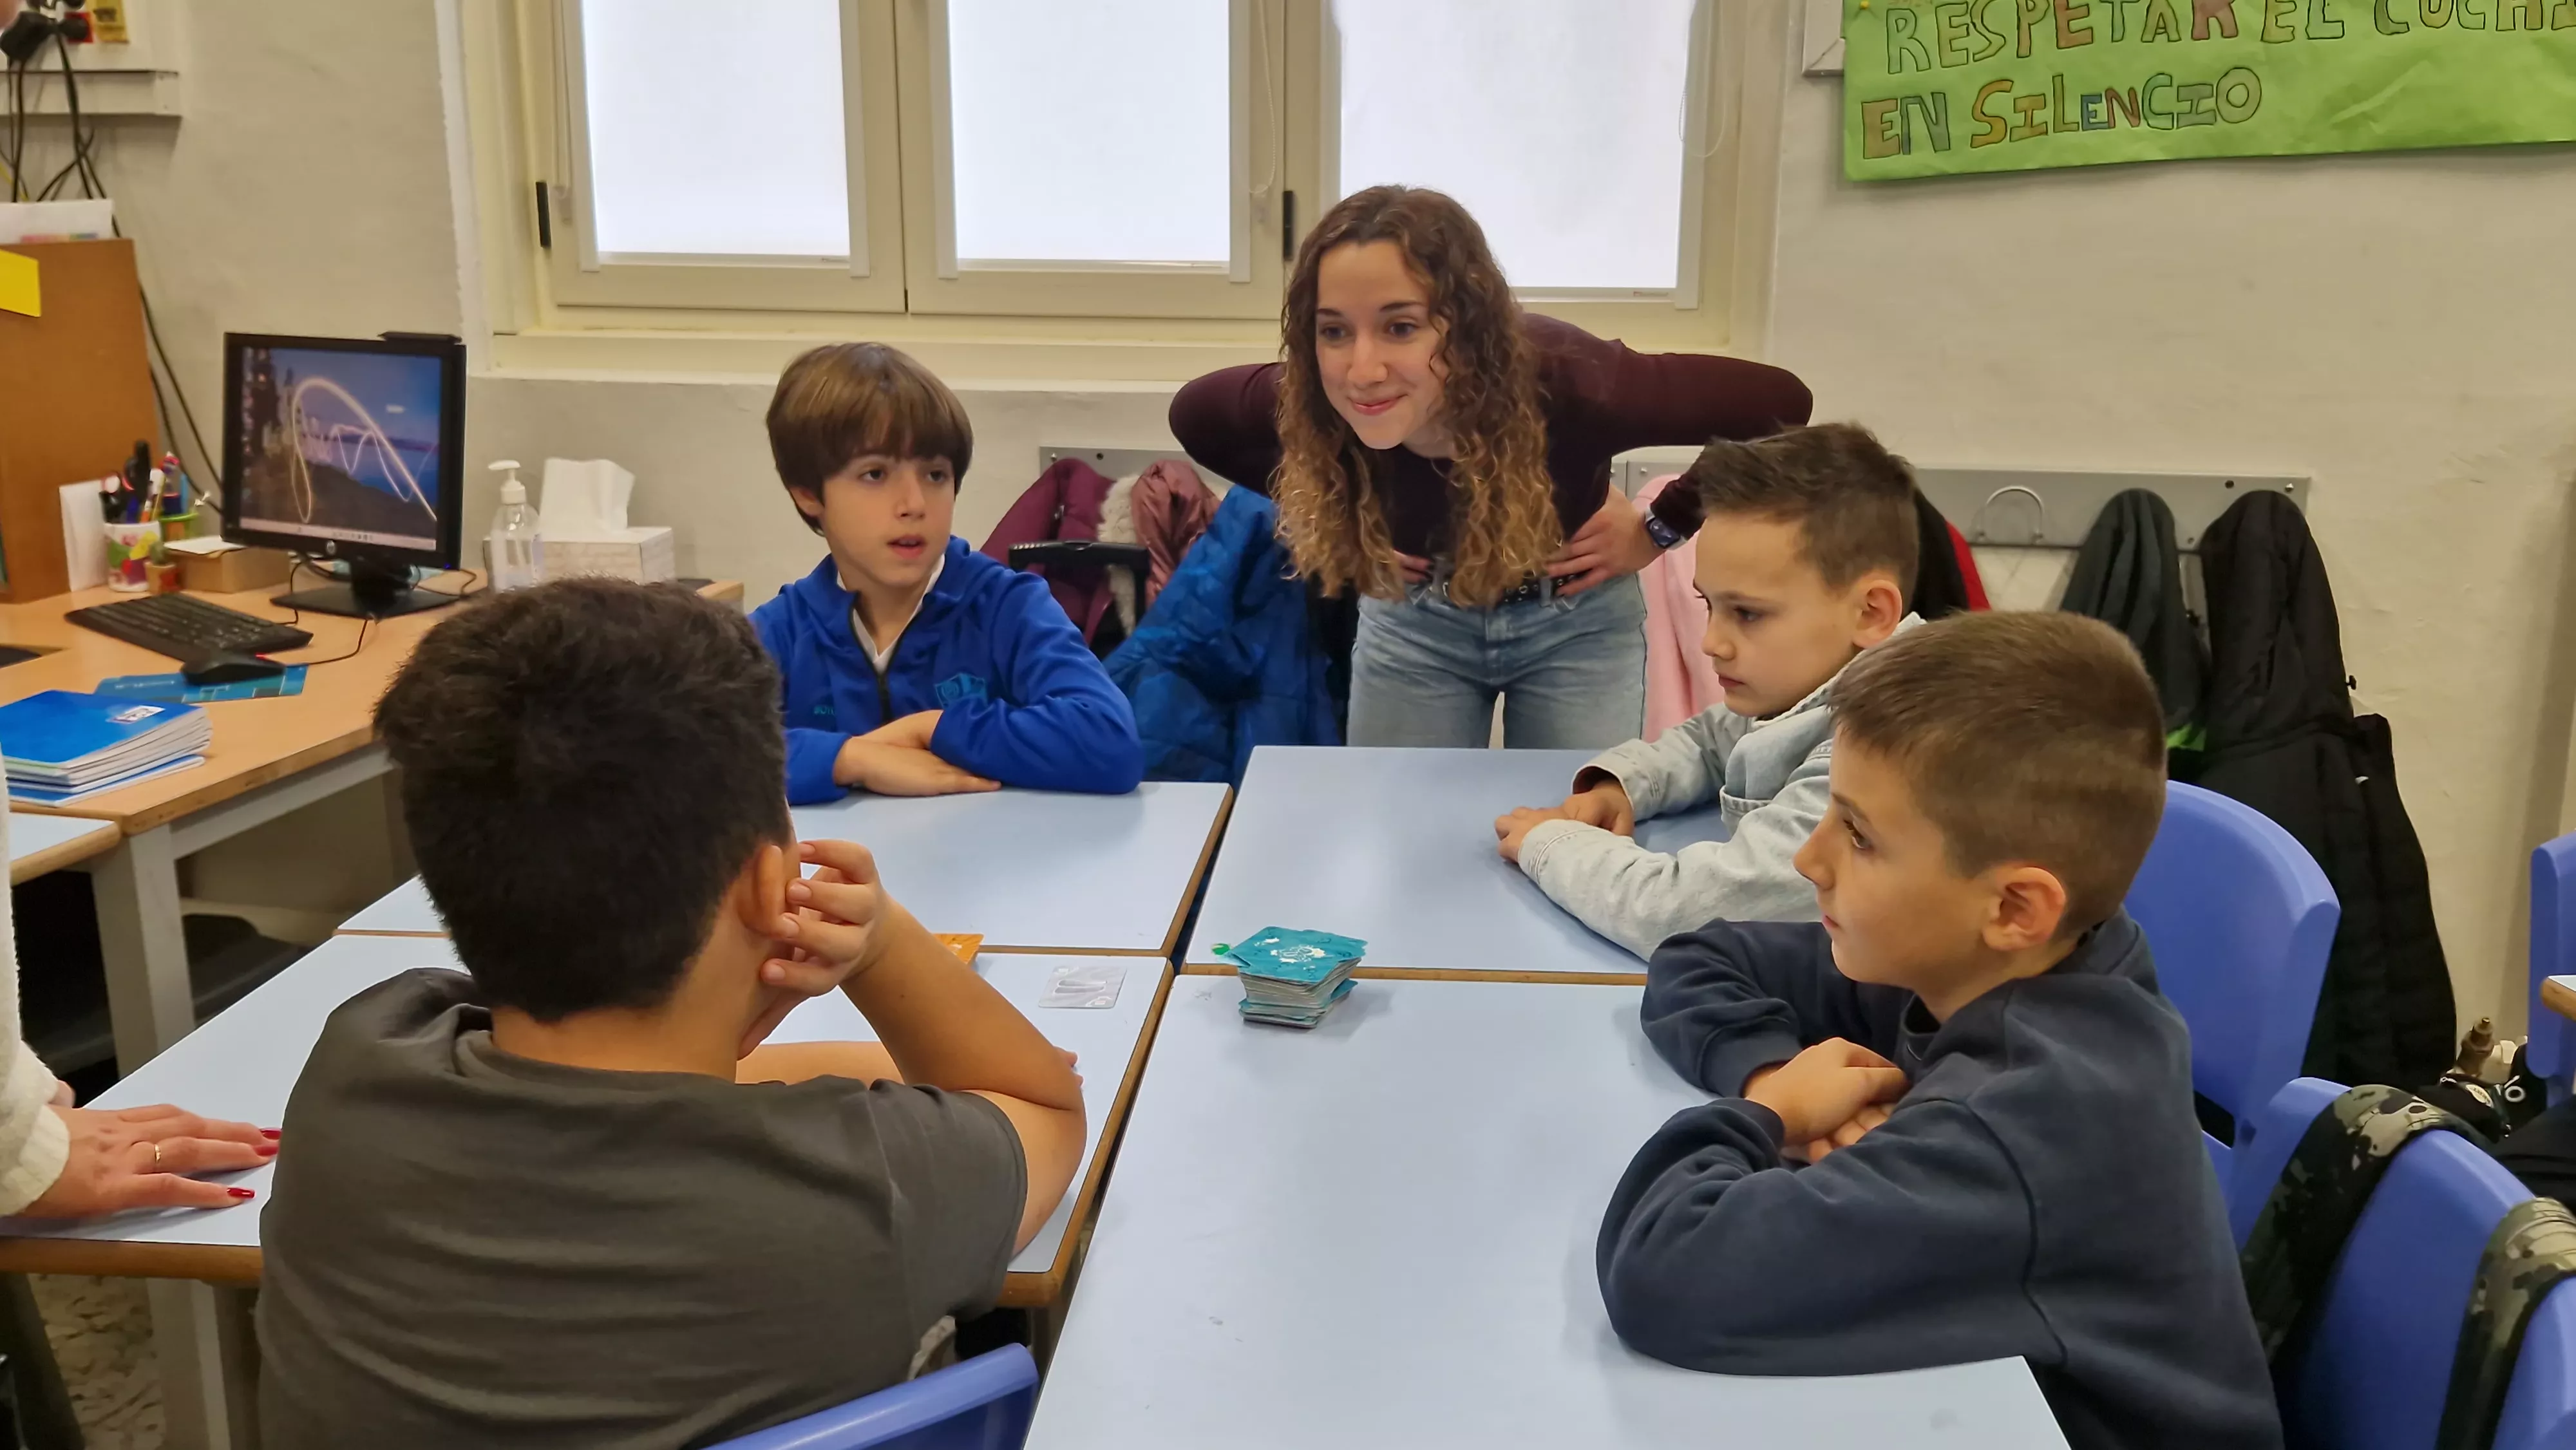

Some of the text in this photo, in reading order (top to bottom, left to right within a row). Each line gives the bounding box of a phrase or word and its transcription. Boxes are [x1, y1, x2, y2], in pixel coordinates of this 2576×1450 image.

[1886, 0, 2239, 75] RESPETAR
[2260, 0, 2345, 44] EL
[1861, 66, 2262, 159] EN SILENCIO
